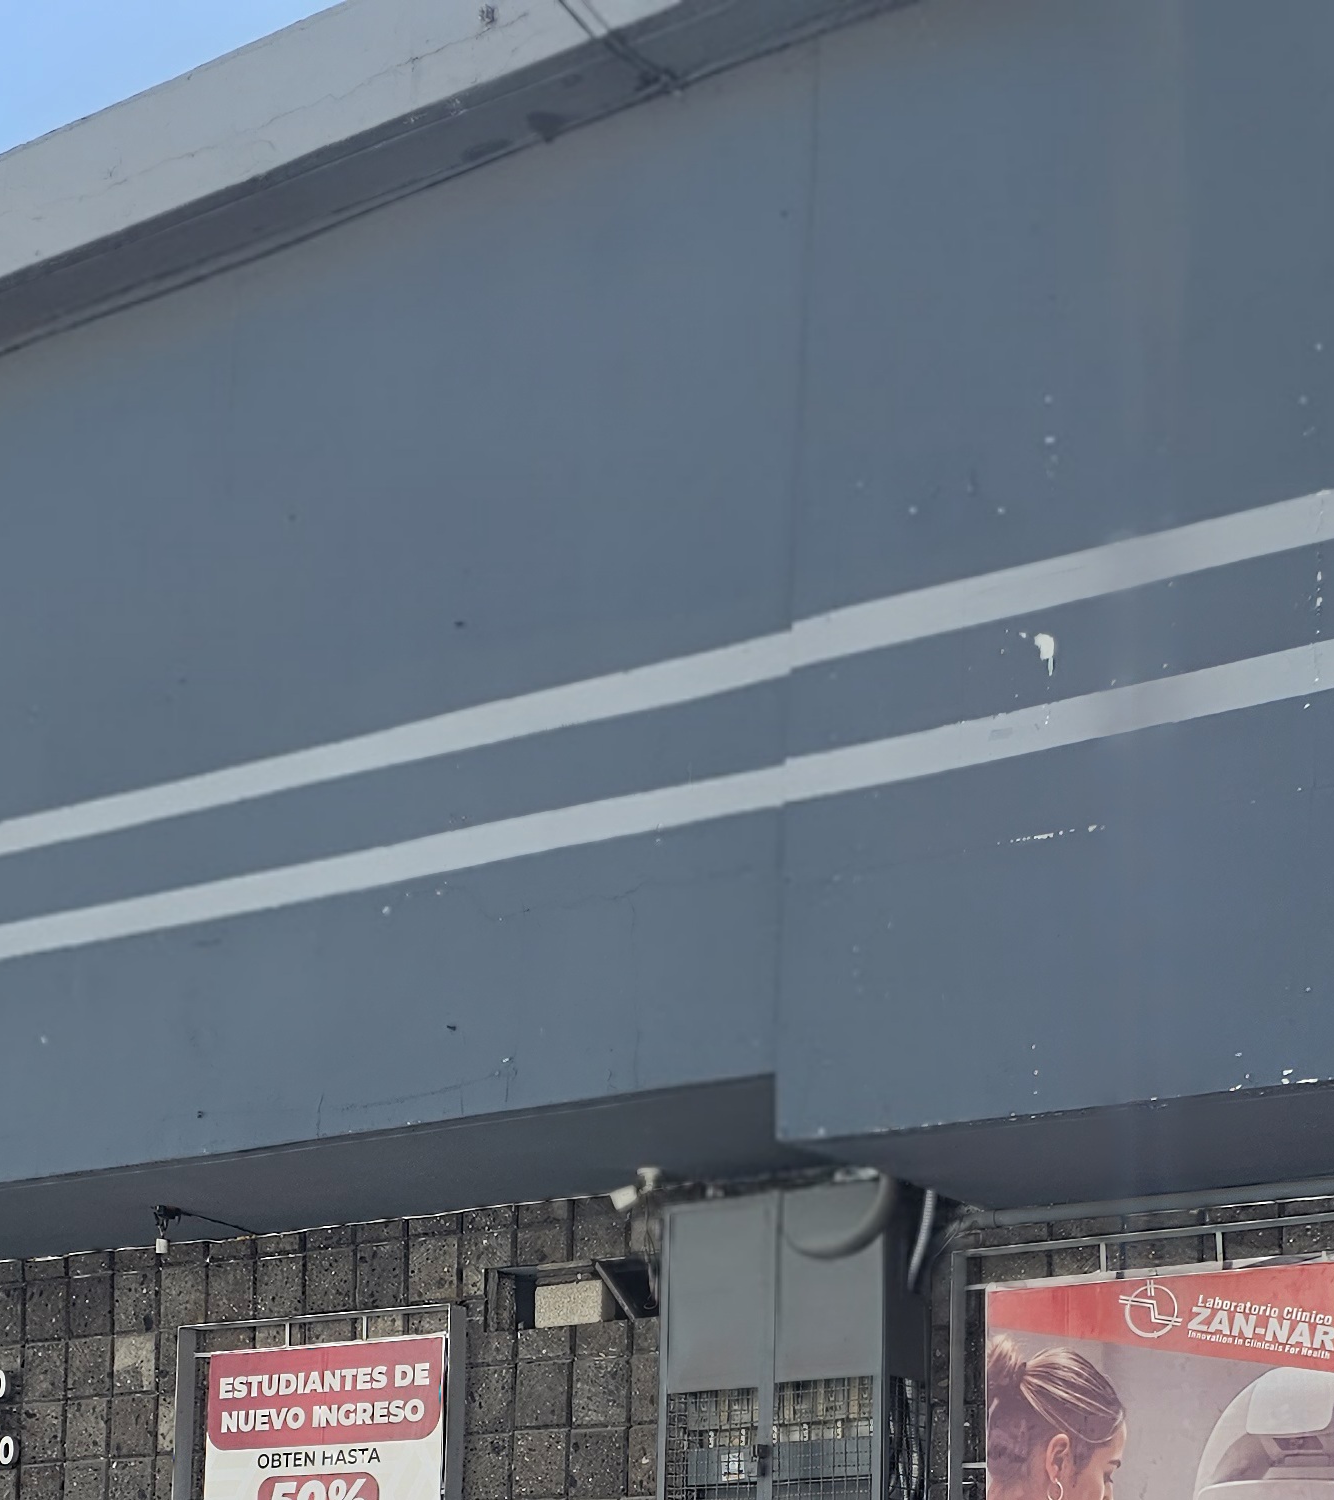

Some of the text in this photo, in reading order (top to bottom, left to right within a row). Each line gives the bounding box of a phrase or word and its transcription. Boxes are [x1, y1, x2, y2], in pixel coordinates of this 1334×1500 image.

[1197, 1294, 1279, 1317] Laboratorio
[1188, 1329, 1232, 1344] Innovation
[1244, 1338, 1283, 1352] Clinicals
[1284, 1345, 1299, 1355] For
[1301, 1347, 1330, 1359] Health
[218, 1362, 430, 1399] ESTUDIANTES DE
[220, 1399, 425, 1433] NUEVO INGRESO
[257, 1447, 381, 1469] OBTEN HASTA
